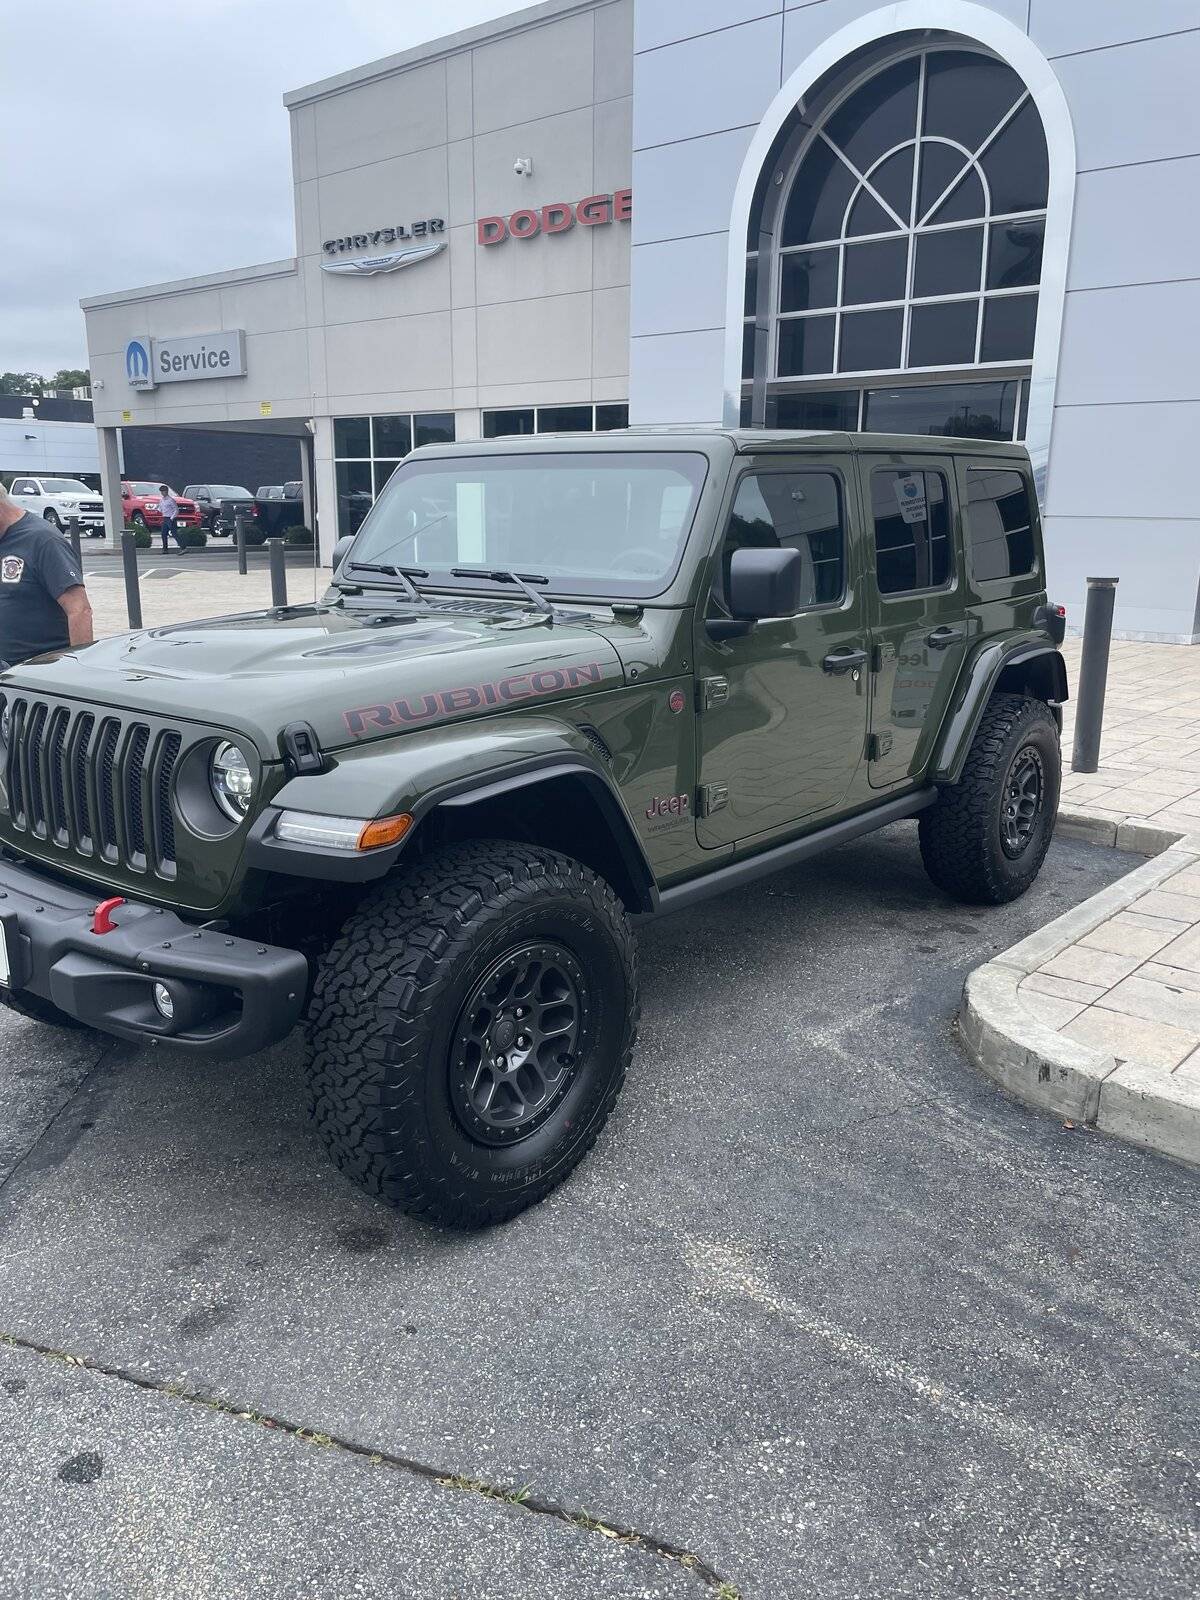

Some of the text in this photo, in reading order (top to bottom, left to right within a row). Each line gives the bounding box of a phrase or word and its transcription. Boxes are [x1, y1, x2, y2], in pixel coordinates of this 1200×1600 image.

[477, 188, 632, 246] DODGE
[322, 218, 445, 255] CHRYSLER
[160, 346, 230, 373] Service
[344, 661, 603, 737] RUBICON
[646, 793, 689, 820] Jeep
